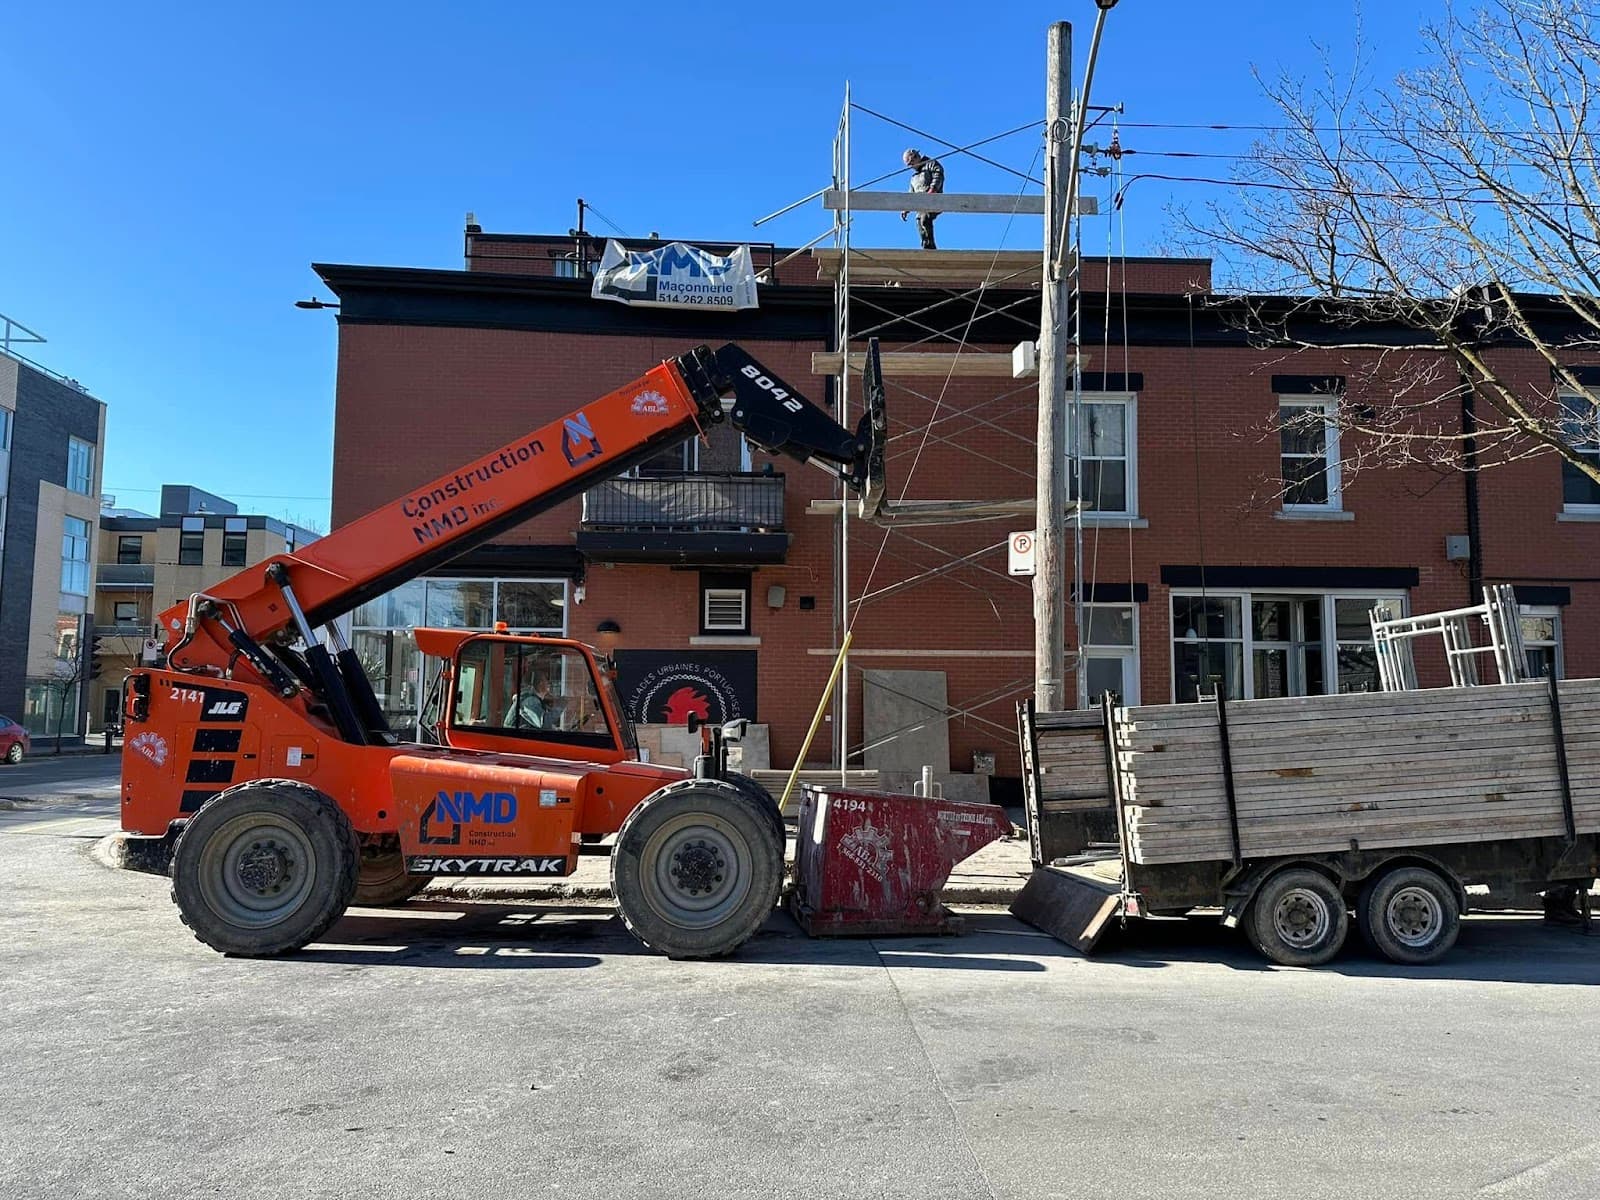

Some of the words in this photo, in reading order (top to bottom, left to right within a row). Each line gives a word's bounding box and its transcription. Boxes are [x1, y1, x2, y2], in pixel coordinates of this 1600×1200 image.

[658, 281, 734, 294] Maçonnerie
[658, 293, 734, 306] 514.262.8509
[740, 364, 803, 413] 8042
[402, 439, 545, 518] Construction
[413, 506, 469, 544] NMD
[170, 687, 206, 704] 2141
[656, 663, 701, 676] URBAINES
[703, 666, 741, 719] PORTUGAISES
[208, 701, 242, 715] JLG
[435, 791, 518, 825] NMD
[832, 799, 867, 813] 4194
[468, 830, 517, 838] Construction
[410, 859, 563, 872] SKYTRAK
